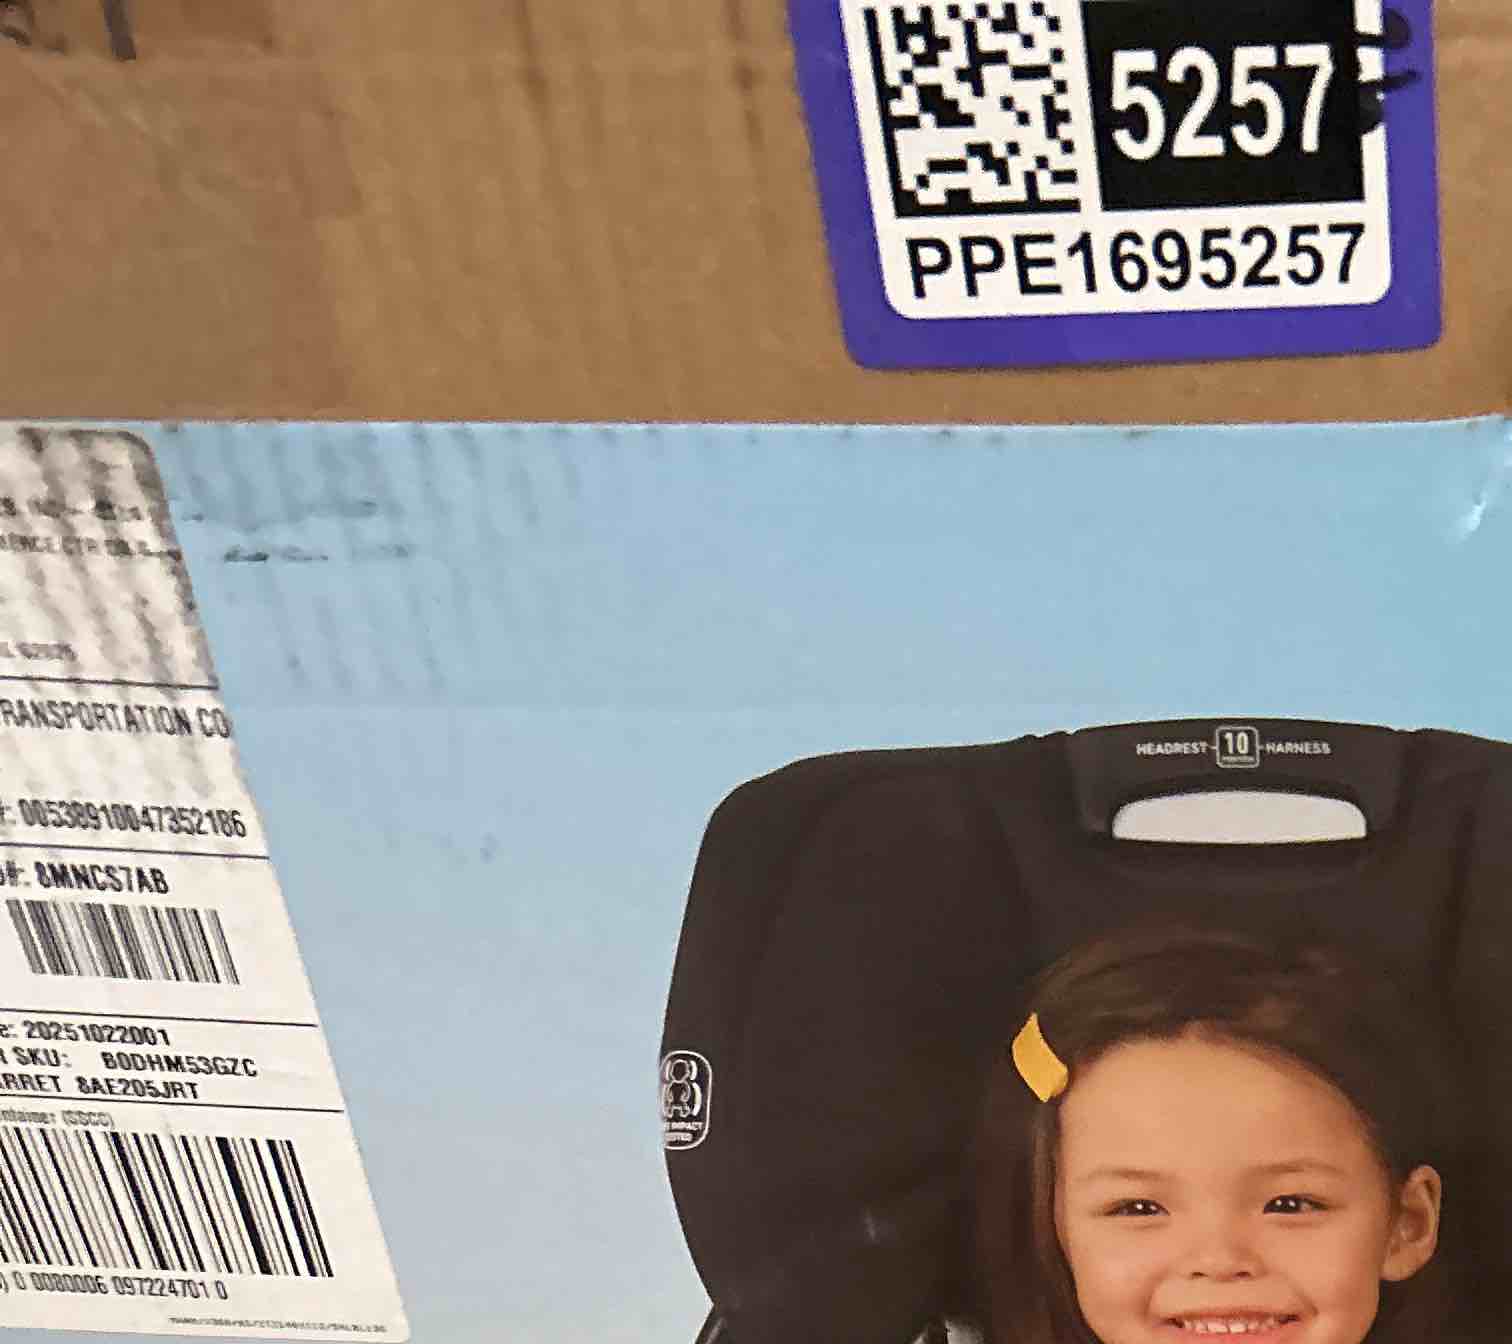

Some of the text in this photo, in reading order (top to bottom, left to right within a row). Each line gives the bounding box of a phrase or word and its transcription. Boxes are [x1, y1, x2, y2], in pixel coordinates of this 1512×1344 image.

[1110, 43, 1333, 160] 5257
[905, 223, 1366, 299] PPE1695257
[1136, 731, 1331, 756] HEADREST 10 HARNESS
